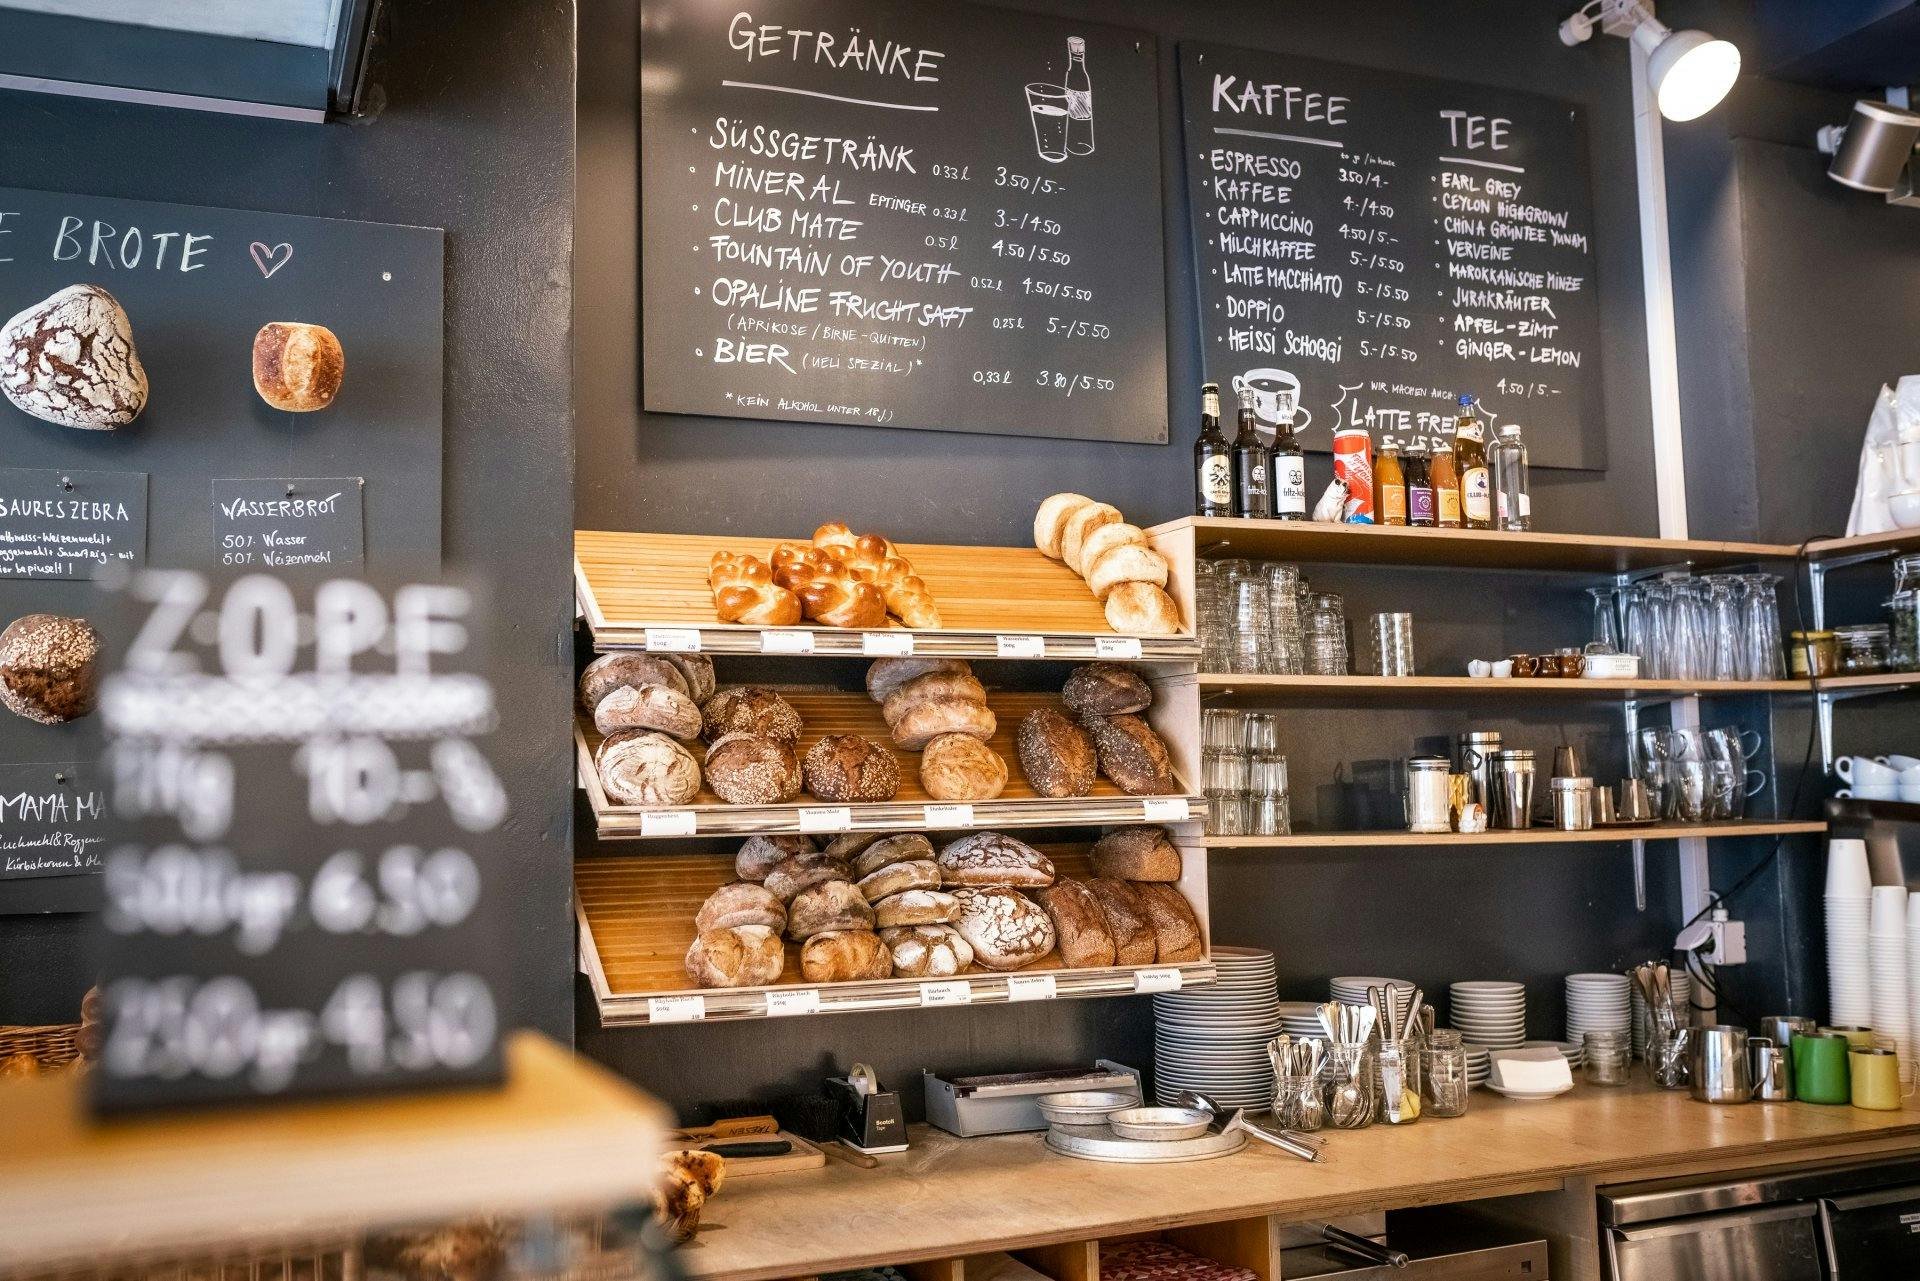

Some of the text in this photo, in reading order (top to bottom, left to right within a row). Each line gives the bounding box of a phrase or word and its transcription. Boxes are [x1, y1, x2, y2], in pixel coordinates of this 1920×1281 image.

[729, 12, 945, 82] GETRÄNKE
[1212, 74, 1351, 125] KAFFEE
[710, 117, 916, 173] SÜSSGETRÄNK
[1439, 110, 1513, 151] TEE
[1210, 149, 1301, 180] ESPRESSO
[715, 161, 855, 205] MINERAL
[869, 193, 926, 216] EPTINGER
[1214, 176, 1292, 204] KAFFEE
[1441, 172, 1522, 200] EARL GREY
[715, 197, 782, 233] CLUB
[790, 209, 863, 240] MATE
[1442, 193, 1491, 214] CEYLON
[1217, 206, 1314, 236] CAPPUCCINO
[1444, 215, 1486, 237] CHINA
[1490, 220, 1547, 242] GRÜNTEE
[53, 215, 214, 272] BROTE
[1220, 231, 1317, 260] MILCHKAFFEE
[1447, 238, 1514, 261] VERVEINE
[709, 235, 832, 276] FOUNTAIN
[840, 255, 874, 277] OF
[880, 255, 961, 284] YOUTH
[1223, 261, 1263, 287] LATTE
[1267, 267, 1343, 299] MACCHIATO
[1449, 261, 1584, 292] MAROKKANISCHE MINZE
[712, 278, 821, 313] OPALINE
[1227, 294, 1285, 324] DOPPIO
[1452, 286, 1556, 319] JURAKRÄUTER
[714, 335, 797, 375] BIER
[1228, 325, 1276, 355] HEISSI
[1283, 329, 1342, 364] SCHOGGI
[1371, 381, 1388, 393] WIR
[1392, 384, 1427, 396] MACHEN
[777, 398, 822, 412] ALKOHOL
[827, 405, 861, 416] UNTER
[1351, 398, 1411, 430] LATTE
[0, 498, 129, 521] SAURES ZEBRA
[221, 492, 342, 520] WASSERBROT
[263, 530, 307, 547] Wasser
[263, 550, 331, 566] Weizenmehl
[0, 792, 68, 823] MAMA
